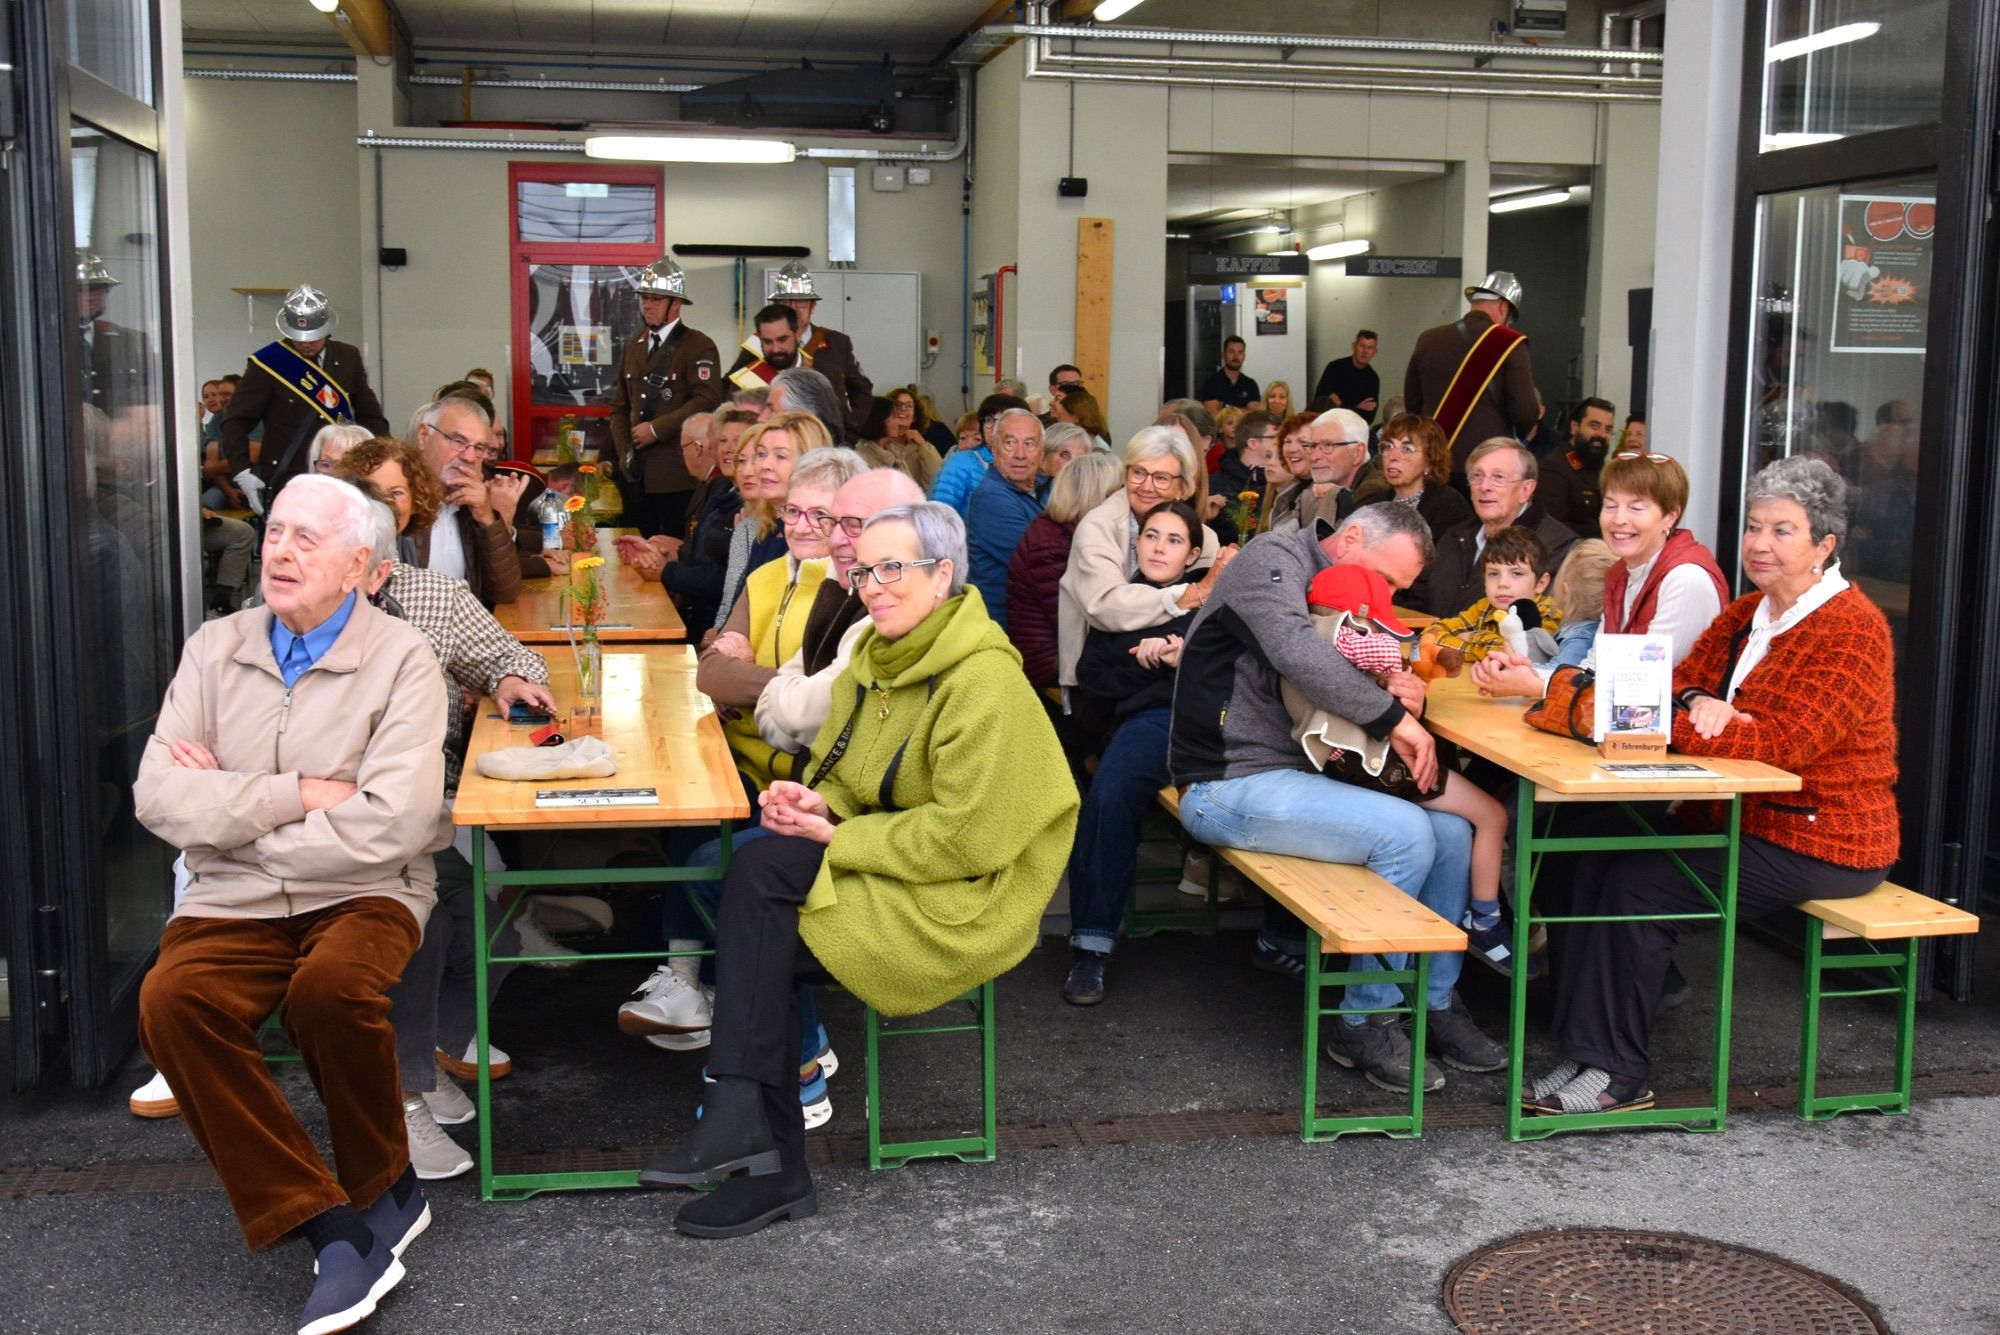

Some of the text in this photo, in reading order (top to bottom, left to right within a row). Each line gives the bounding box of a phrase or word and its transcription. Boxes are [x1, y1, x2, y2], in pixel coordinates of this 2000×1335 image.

[1216, 257, 1280, 273] KAFFEE
[1368, 260, 1438, 276] KUCHEN
[816, 748, 842, 779] DANCE
[837, 741, 846, 749] &
